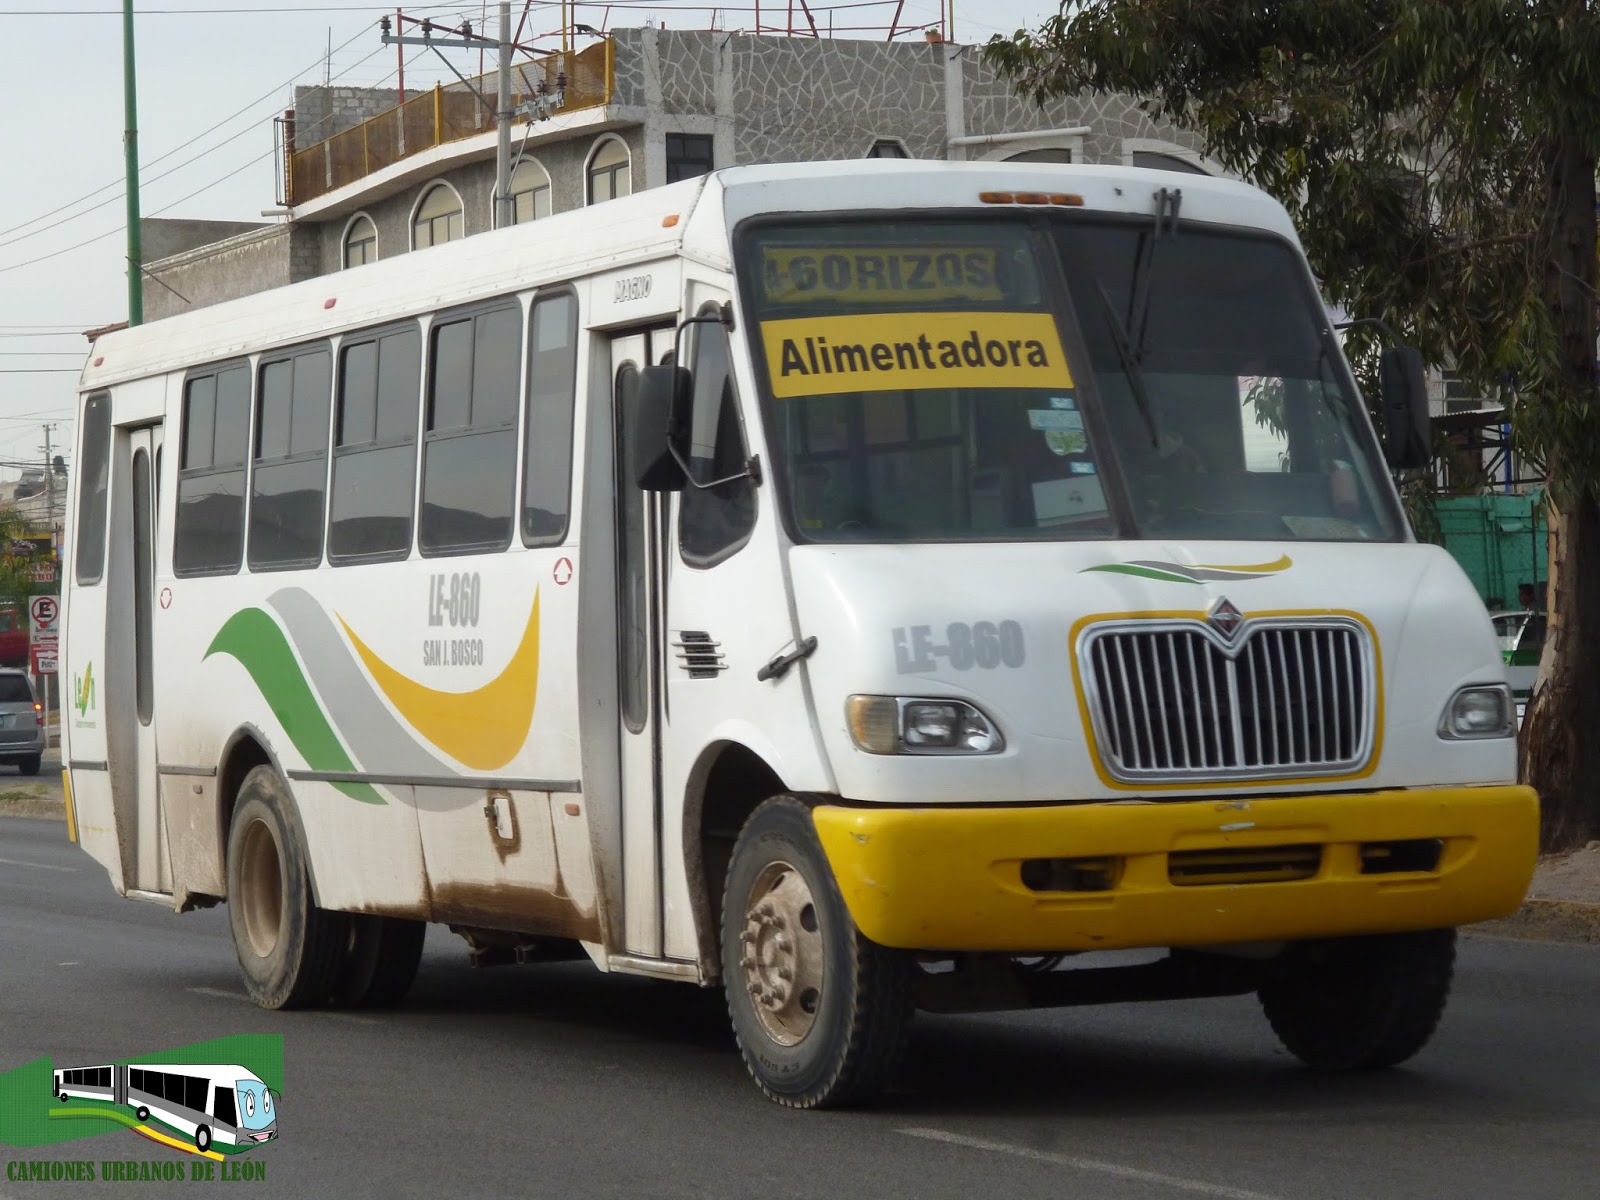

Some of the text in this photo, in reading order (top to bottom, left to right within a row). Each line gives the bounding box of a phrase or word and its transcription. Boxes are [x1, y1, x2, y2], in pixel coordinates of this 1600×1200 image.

[613, 274, 652, 304] MAGNO
[781, 331, 1049, 376] Alimentadora
[428, 571, 481, 628] LE-860
[423, 638, 483, 666] SAN J. BOSCO
[891, 619, 1026, 675] LE-860
